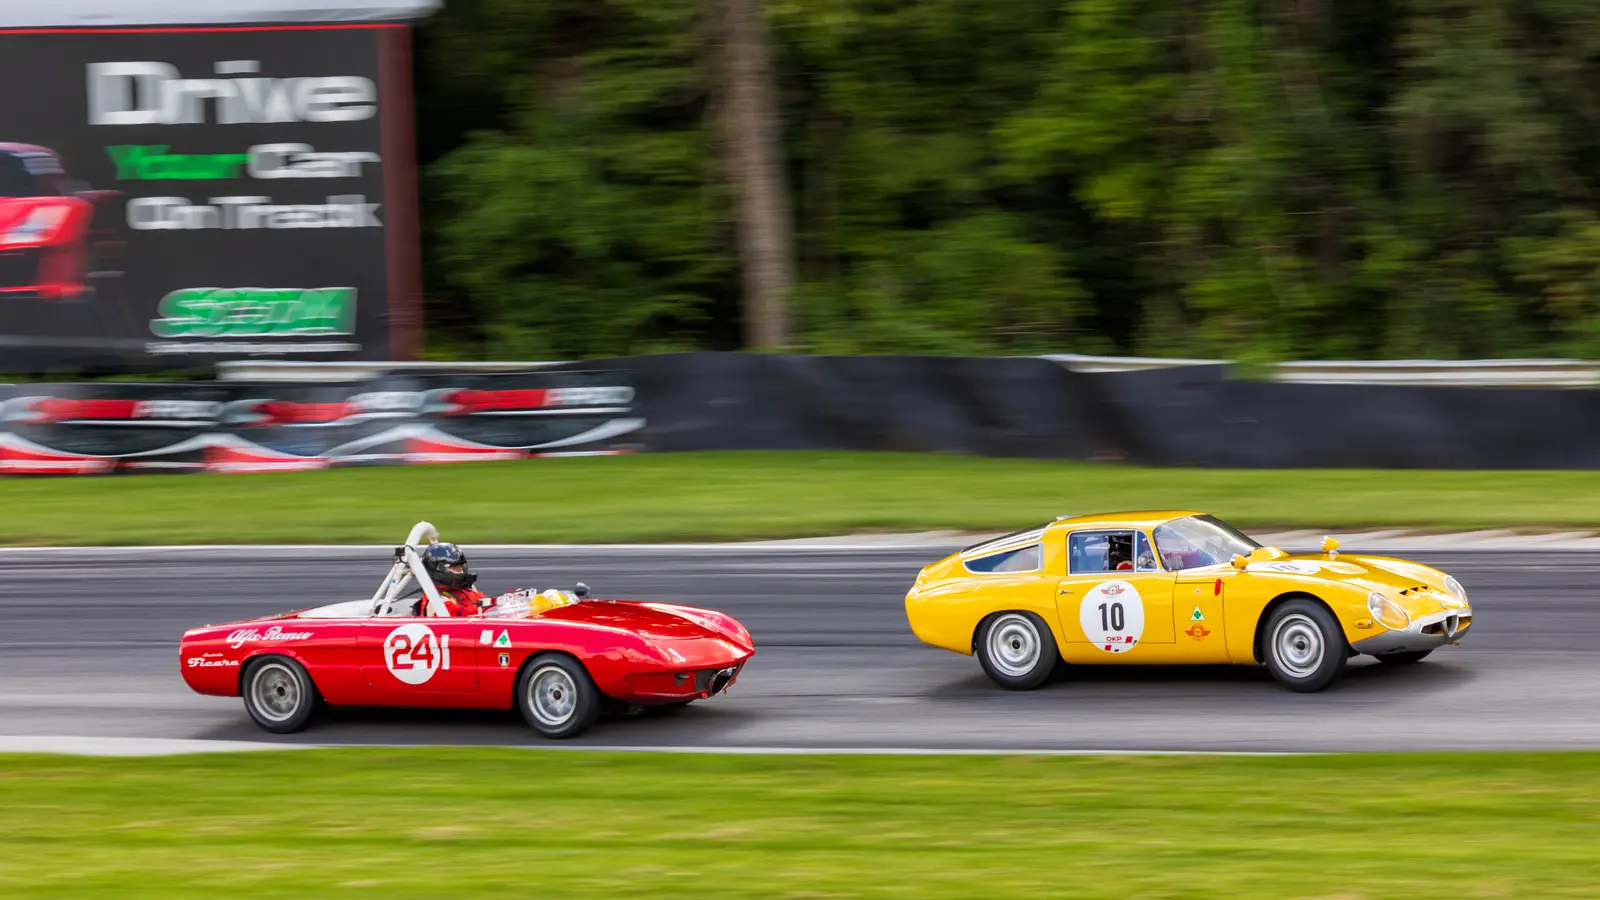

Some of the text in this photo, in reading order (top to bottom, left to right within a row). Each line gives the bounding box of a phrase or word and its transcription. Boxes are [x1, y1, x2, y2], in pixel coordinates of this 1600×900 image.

[86, 60, 377, 125] Drive
[104, 143, 381, 180] Your Car
[126, 195, 383, 229] On Track
[1098, 602, 1124, 631] 10
[226, 625, 314, 649] Alfa Romeo
[389, 634, 450, 671] 241
